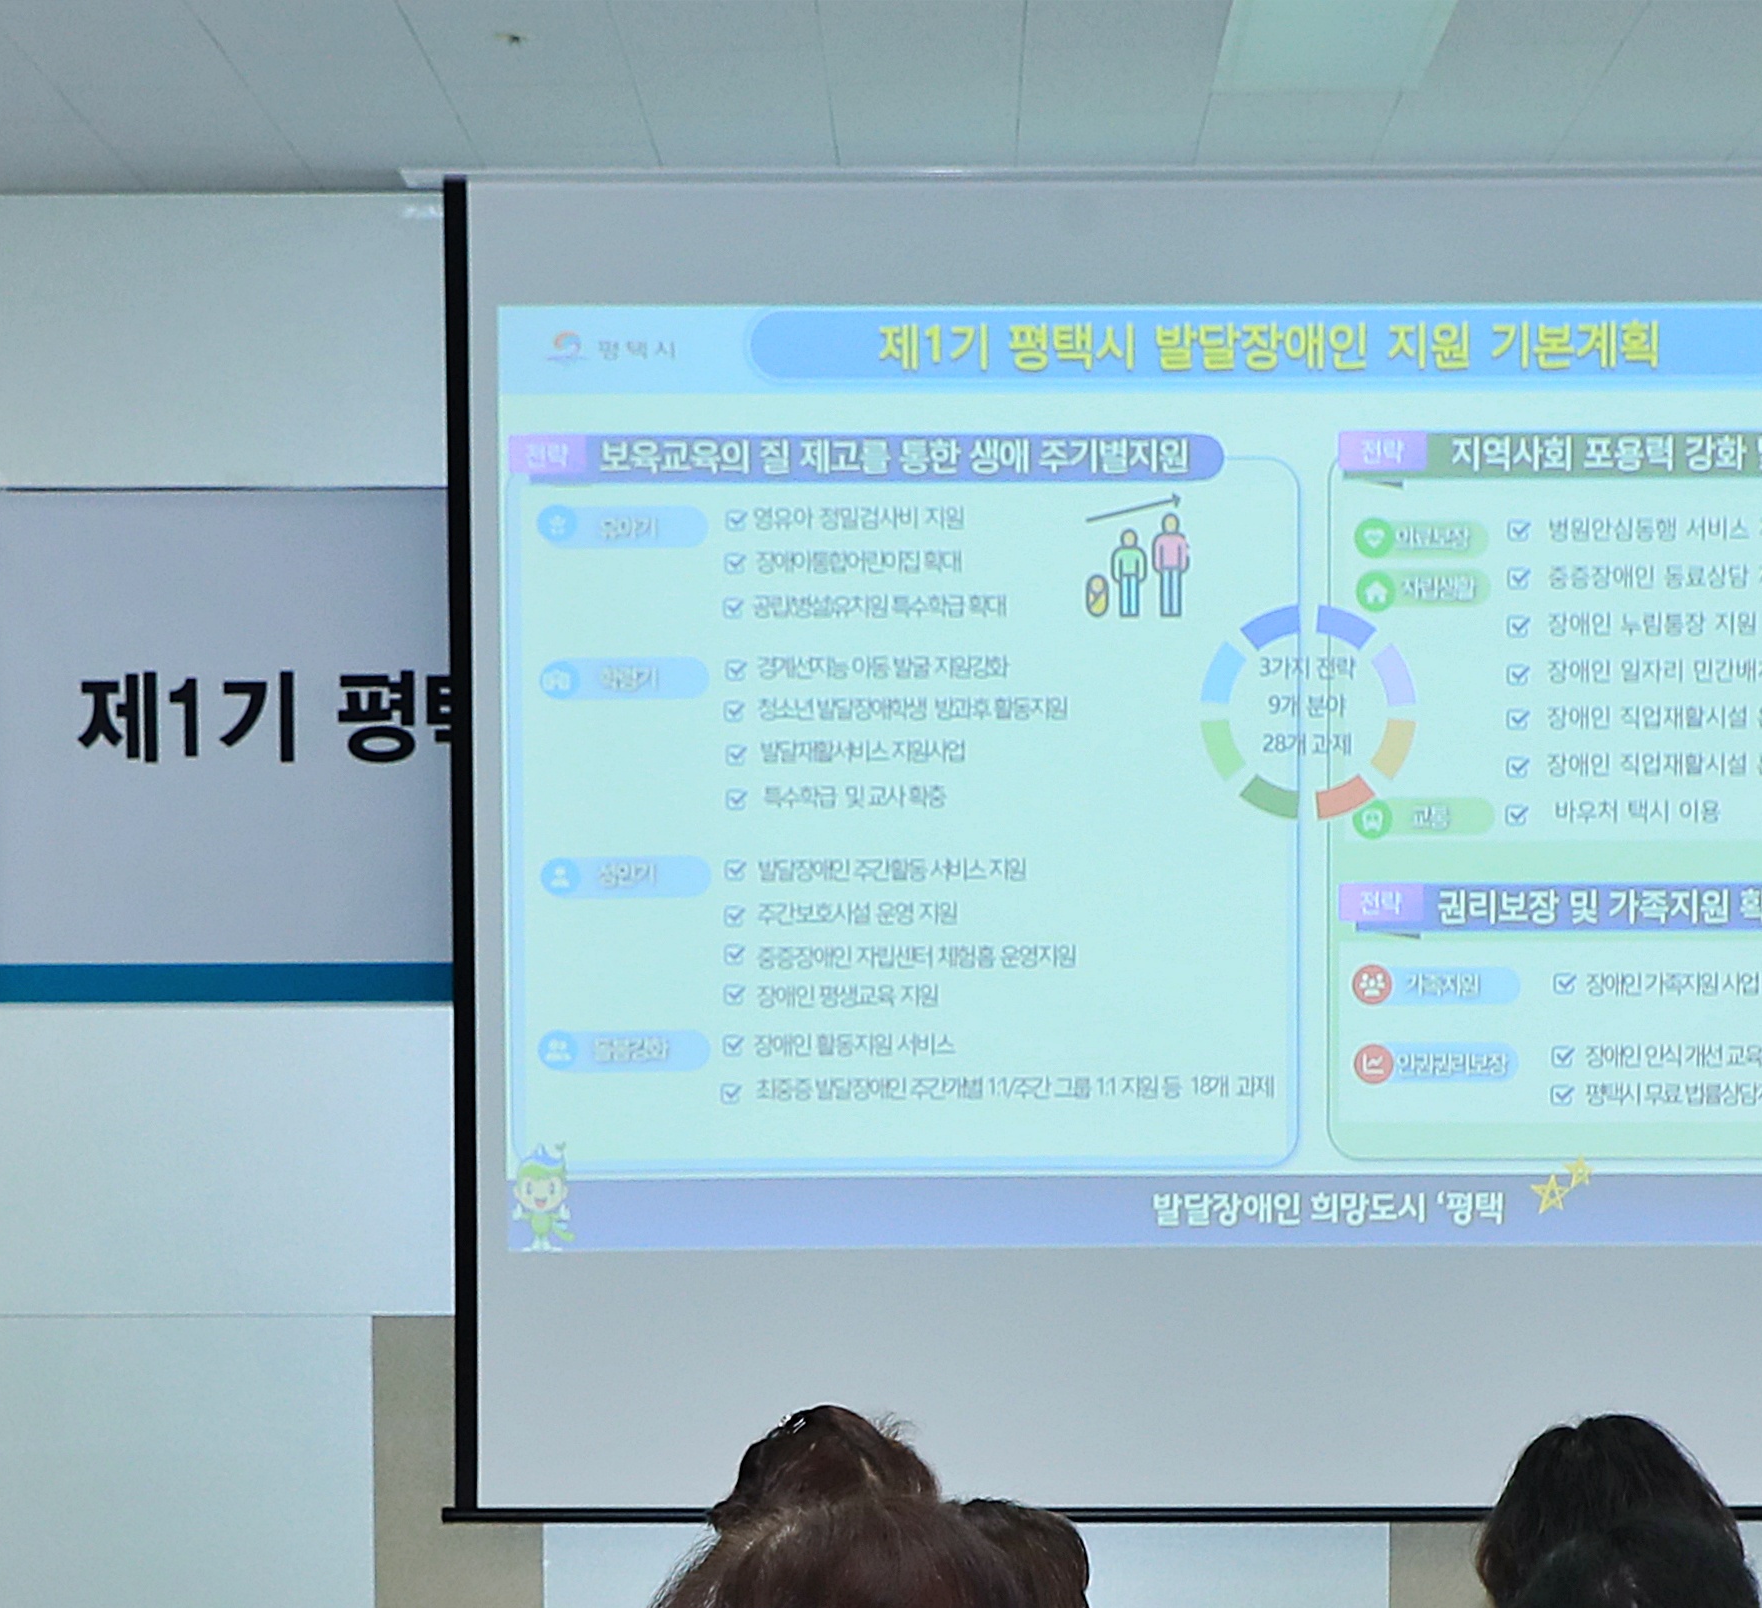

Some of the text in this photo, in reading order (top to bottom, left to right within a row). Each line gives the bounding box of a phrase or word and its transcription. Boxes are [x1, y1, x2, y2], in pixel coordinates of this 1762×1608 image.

[879, 319, 1661, 372] 제1기 평택시 발달장애인 지원 기본계획
[598, 437, 1190, 475] 보육교육의 질 제고를 통한 생애 주기별지원
[1360, 438, 1405, 466] 전략
[1451, 433, 1575, 473] 지역사회
[1583, 433, 1674, 473] 포용력
[1684, 433, 1748, 473] 강화
[752, 506, 966, 531] 영유아 정밀검사비 지원
[1547, 516, 1678, 543] 병원안심동행
[1685, 516, 1751, 543] 서비스
[925, 550, 964, 575] 확대
[1547, 564, 1655, 590] 중증장애인
[1663, 564, 1750, 590] 동료상담
[892, 594, 966, 619] 특수학급
[969, 594, 1008, 619] 확대
[1547, 612, 1758, 638] 장애인 누림통장 지원
[852, 655, 889, 681] 아동
[893, 655, 932, 681] 발굴
[1258, 656, 1357, 681] 3가지 전략
[1547, 659, 1612, 685] 장애인
[1620, 658, 1684, 684] 일자리
[77, 669, 296, 764] 제1기
[1268, 694, 1347, 718] 9개 분야
[1547, 704, 1612, 731] 장애인
[1620, 704, 1748, 731] 직업재활시설
[893, 739, 966, 764] 지원사업
[1262, 733, 1352, 756] 28개 과제
[1546, 751, 1611, 778] 장애인
[1619, 751, 1748, 778] 직업재활시설
[763, 785, 838, 809] 특수학급
[844, 785, 866, 809] 및
[868, 785, 906, 809] 교사
[1554, 799, 1722, 825] 바우처 택시 이용
[757, 858, 851, 882] 발달장애인
[989, 858, 1028, 882] 지원
[756, 901, 959, 926] 주간보호시설 운영 지원
[1359, 889, 1402, 916] 전략
[1436, 887, 1560, 926] 권리보장
[1568, 887, 1599, 926] 및
[1608, 887, 1730, 926] 가족지원
[1000, 944, 1078, 970] 운영지원
[756, 983, 815, 1009] 장애인
[900, 983, 940, 1009] 지원
[1586, 971, 1761, 997] 장애인 가족지원 사업
[752, 1033, 957, 1058] 장애인 활동지원 서비스
[1585, 1044, 1642, 1069] 장애인
[1644, 1044, 1683, 1069] 인식
[1685, 1044, 1724, 1069] 개선
[1054, 1075, 1093, 1099] 그룹
[1121, 1074, 1160, 1099] 지원
[1161, 1075, 1183, 1099] 등
[1190, 1074, 1230, 1098] 18개
[1237, 1074, 1276, 1099] 과제
[1585, 1083, 1641, 1107] 평택시
[1644, 1083, 1683, 1107] 무료
[1152, 1191, 1301, 1228] 발달장애인
[1310, 1190, 1427, 1227] 희망도시
